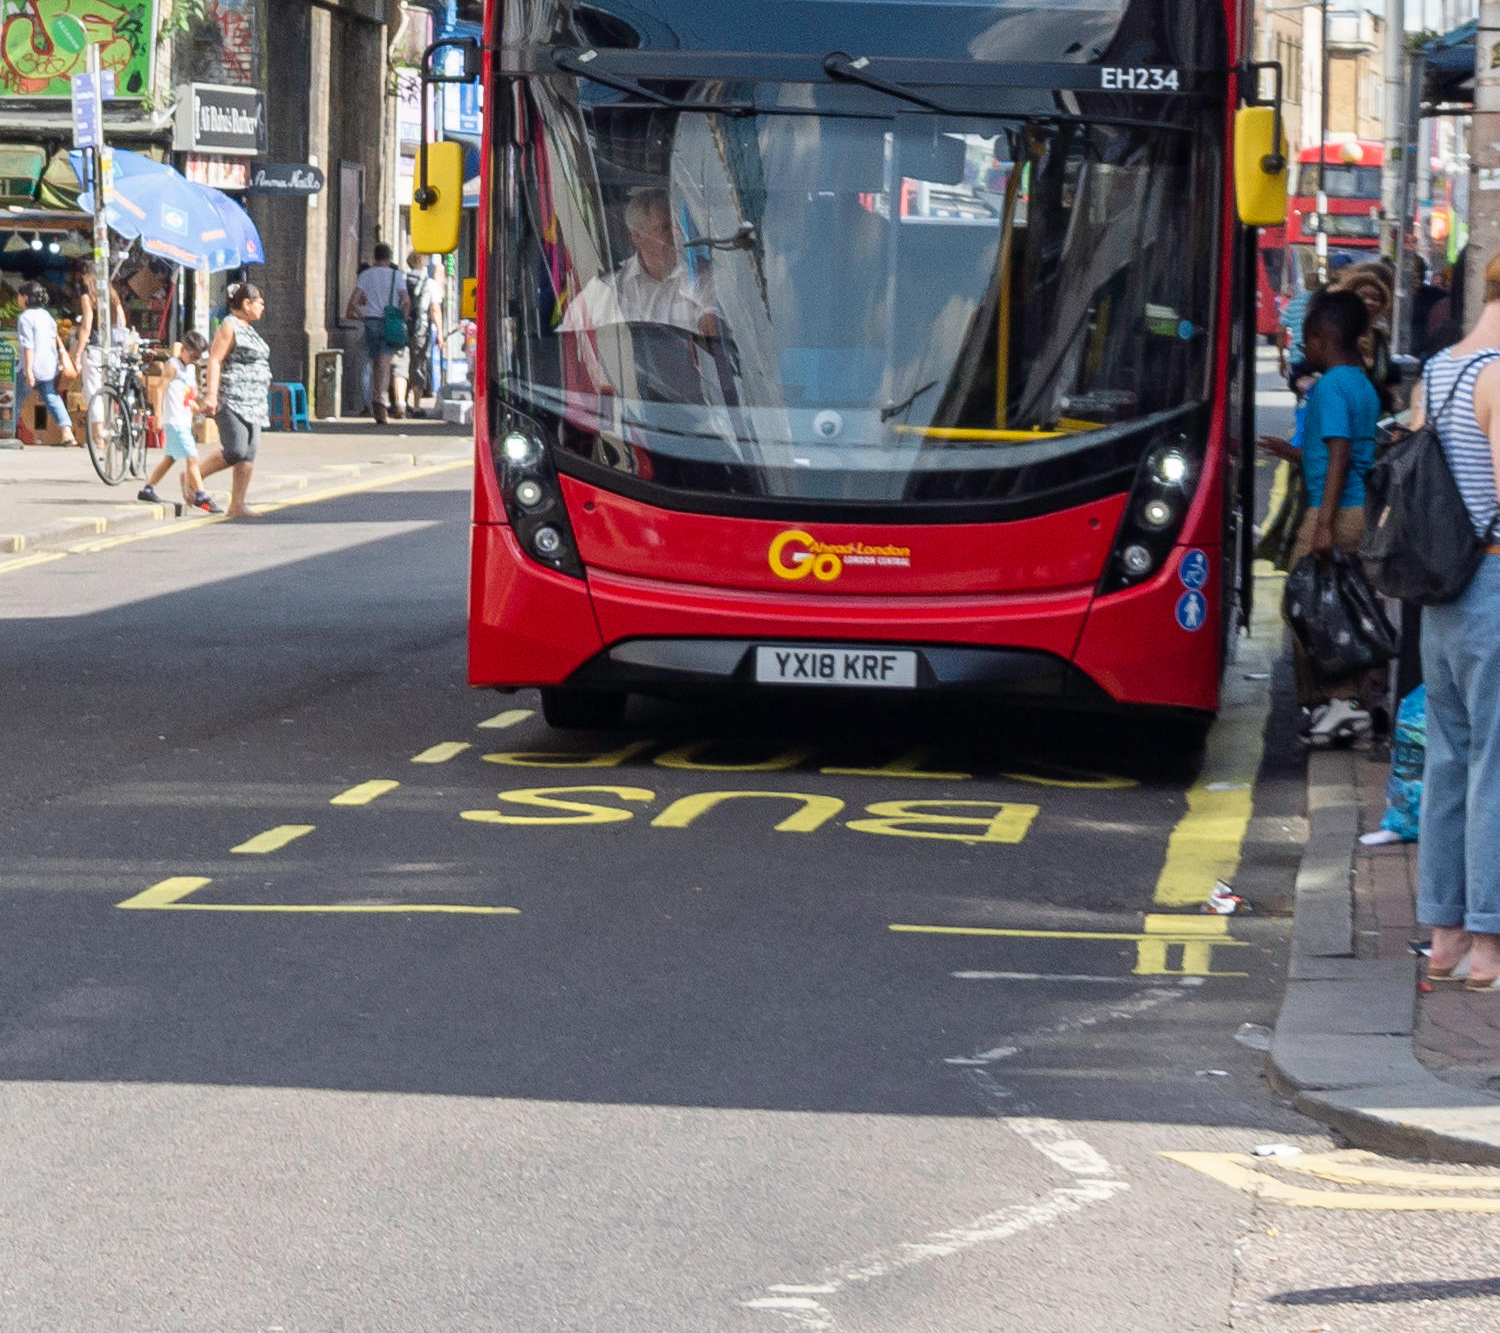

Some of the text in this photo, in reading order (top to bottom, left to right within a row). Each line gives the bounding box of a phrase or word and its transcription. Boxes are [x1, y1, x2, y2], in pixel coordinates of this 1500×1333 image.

[1101, 66, 1179, 92] EH234
[768, 530, 843, 581] Go
[774, 651, 897, 680] YX18 KRF
[461, 786, 1040, 844] BUS
